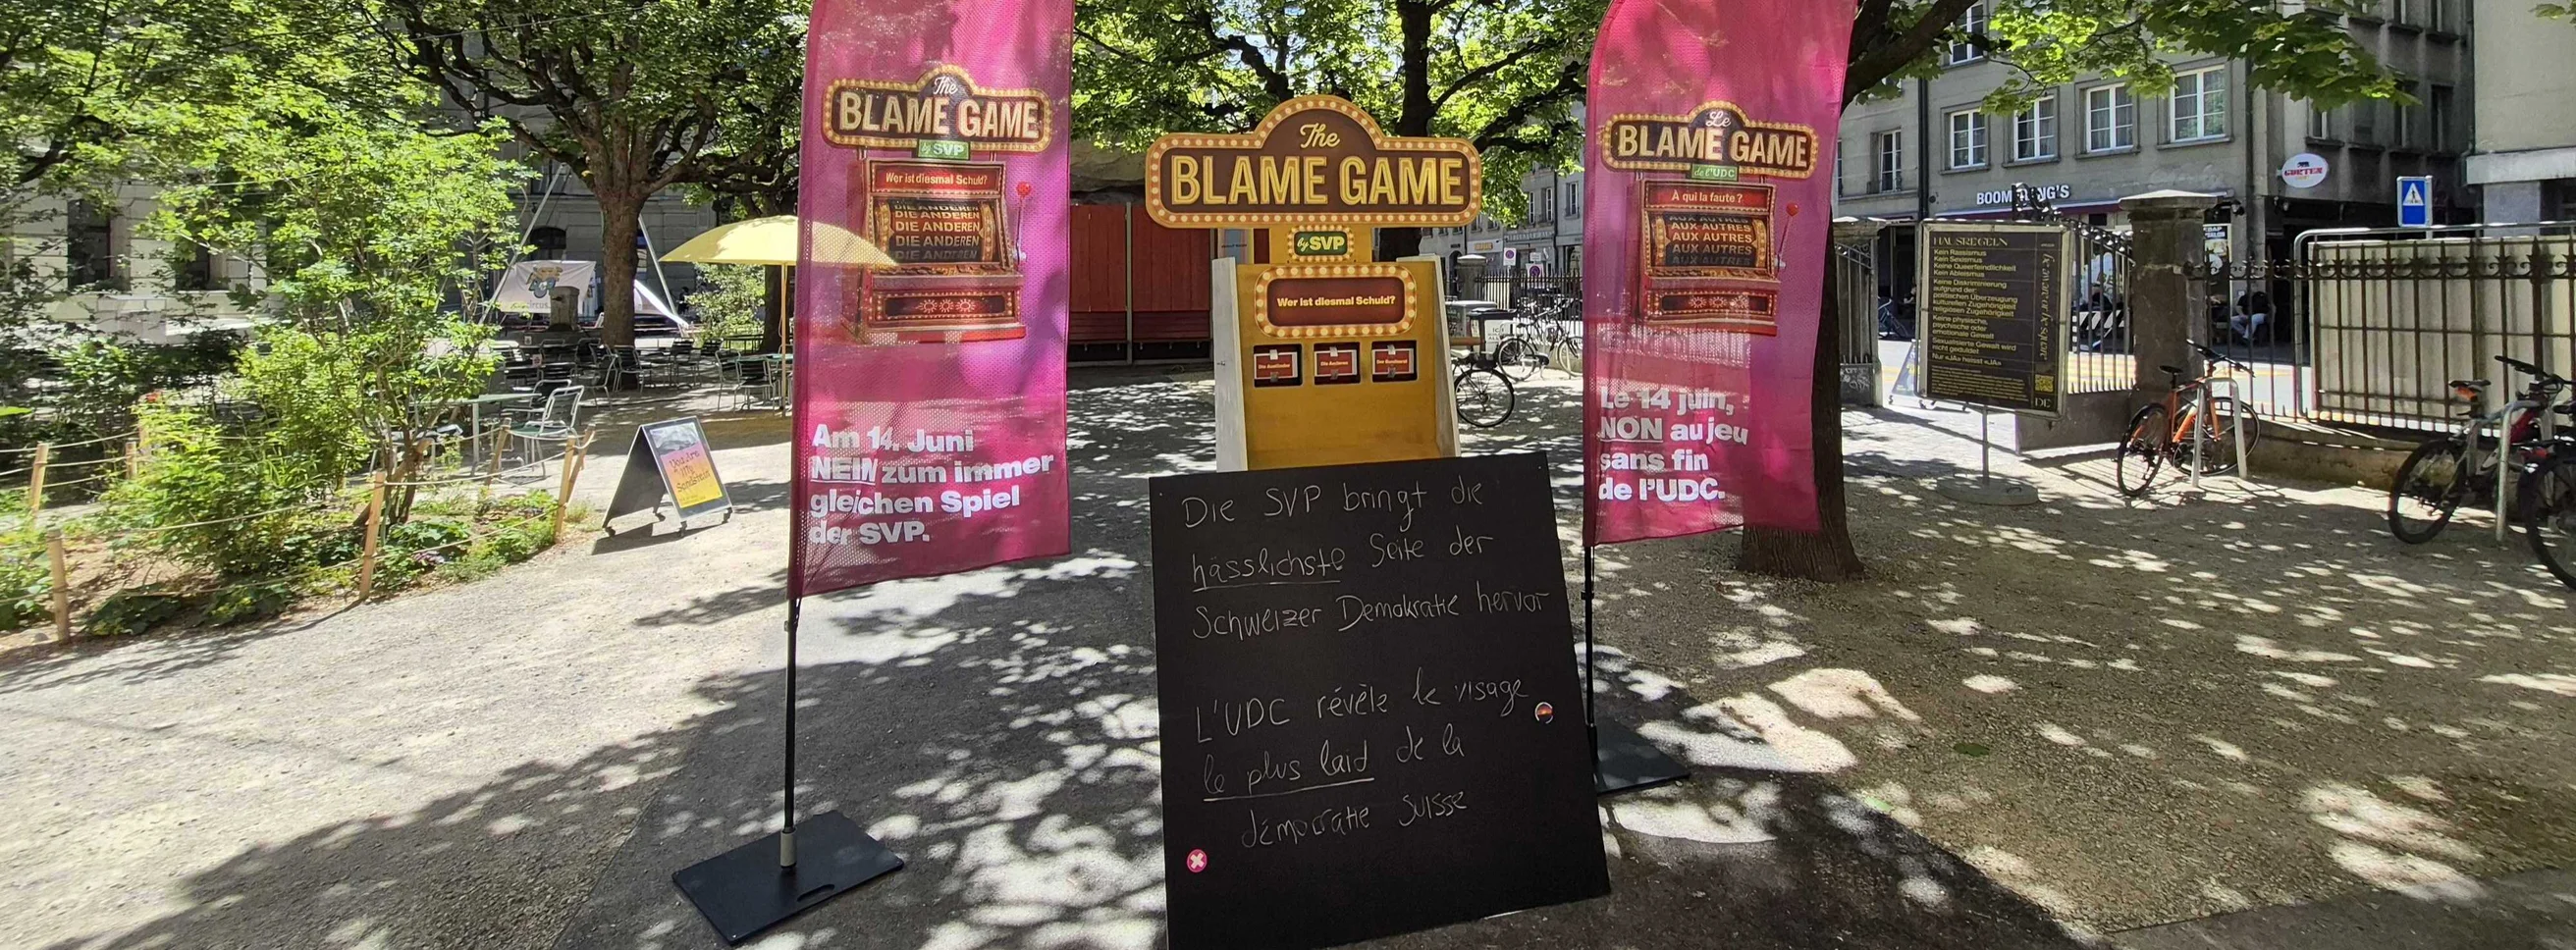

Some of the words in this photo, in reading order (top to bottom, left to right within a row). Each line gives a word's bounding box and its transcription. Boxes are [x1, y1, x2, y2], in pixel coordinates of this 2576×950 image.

[933, 76, 958, 95] The
[839, 91, 949, 135] BLAME
[958, 99, 1041, 138] GAME
[1705, 110, 1731, 128] Le
[1299, 123, 1340, 148] The
[933, 144, 964, 156] SVP
[1618, 125, 1723, 161] BLAME
[1731, 131, 1807, 168] GAME
[2284, 167, 2323, 176] GURTEN
[886, 173, 902, 184] Wer
[905, 174, 914, 184] ist
[916, 174, 953, 185] diesmal
[955, 176, 988, 185] Schuld?
[1171, 155, 1328, 205] BLAME
[1339, 155, 1464, 205] GAME
[1672, 189, 1680, 200] À
[1683, 191, 1697, 203] qui
[1699, 191, 1708, 201] la
[1710, 191, 1735, 203] faute
[921, 211, 980, 220] ANDEREN
[895, 221, 920, 232] DIE
[922, 221, 980, 233] ANDEREN
[1701, 223, 1751, 233] AUTRES
[895, 236, 920, 246] DIE
[923, 235, 980, 246] ANDEREN
[1310, 236, 1345, 250] SVP
[1672, 232, 1699, 241] AUX
[1703, 233, 1752, 243] AUTRES
[1933, 237, 2008, 246] HAUSREGELN
[1672, 244, 1699, 253] AUX
[1702, 244, 1752, 254] AUTRES
[1954, 263, 2016, 272] Queerfeindlichkeit
[1933, 286, 1962, 294] aufgrund
[1954, 280, 2008, 290] Diskriminierung
[1277, 297, 1298, 307] Wer
[1300, 296, 1314, 306] ist
[1315, 296, 1355, 306] diesmal
[1356, 295, 1396, 305] Schuld?
[1933, 292, 1969, 301] politischen
[1970, 293, 2018, 304] Überzeugung
[1933, 306, 1965, 315] religiösen
[1966, 308, 2014, 318] Zugehörigkeit
[1967, 300, 2016, 311] Zugehörigkeit
[1932, 322, 1969, 332] psychische
[1932, 338, 1974, 346] Sexualisierte
[1975, 341, 2000, 349] Gewalt
[1950, 346, 1979, 355] geduldet
[1600, 386, 1631, 409] Le
[1636, 387, 1671, 409] 14
[1677, 387, 1734, 416] juin,
[2035, 397, 2052, 407] DE
[812, 424, 859, 449] Am
[868, 425, 900, 451] 14.
[907, 429, 974, 452] Juni
[1600, 417, 1663, 440] NON
[1670, 423, 1703, 441] au
[1706, 416, 1748, 446] jeu
[669, 457, 685, 469] You
[686, 449, 700, 463] Are
[1600, 452, 1665, 471] sans
[1672, 449, 1709, 471] fin
[811, 456, 878, 482] NEIN
[882, 466, 946, 483] zum
[954, 454, 1054, 483] immer
[675, 470, 711, 493] Sandstein
[1598, 477, 1632, 501] de
[810, 489, 933, 517] gleichen
[940, 485, 1020, 517] Spiel
[1182, 497, 1235, 529] Die
[1264, 485, 1321, 518] SVP
[1343, 482, 1427, 532] bringt
[1451, 476, 1483, 505] die
[809, 519, 852, 545] der
[859, 521, 930, 545] SVP.
[1192, 547, 1346, 589] hässlichste
[1370, 532, 1424, 567] Seite
[1449, 526, 1493, 556] der
[1192, 606, 1322, 641] Schweizer
[1336, 594, 1459, 633] Demokratie
[1476, 581, 1550, 613] hervor
[1196, 698, 1291, 744] L'UDC
[1317, 685, 1388, 719] révèle
[1413, 667, 1442, 707] le
[1455, 677, 1530, 717] visage
[1204, 755, 1225, 795] le
[1247, 754, 1301, 791] plus
[1320, 740, 1368, 776] laid
[1396, 725, 1424, 764] de
[1443, 722, 1466, 758] la
[1242, 806, 1370, 848] démocratie
